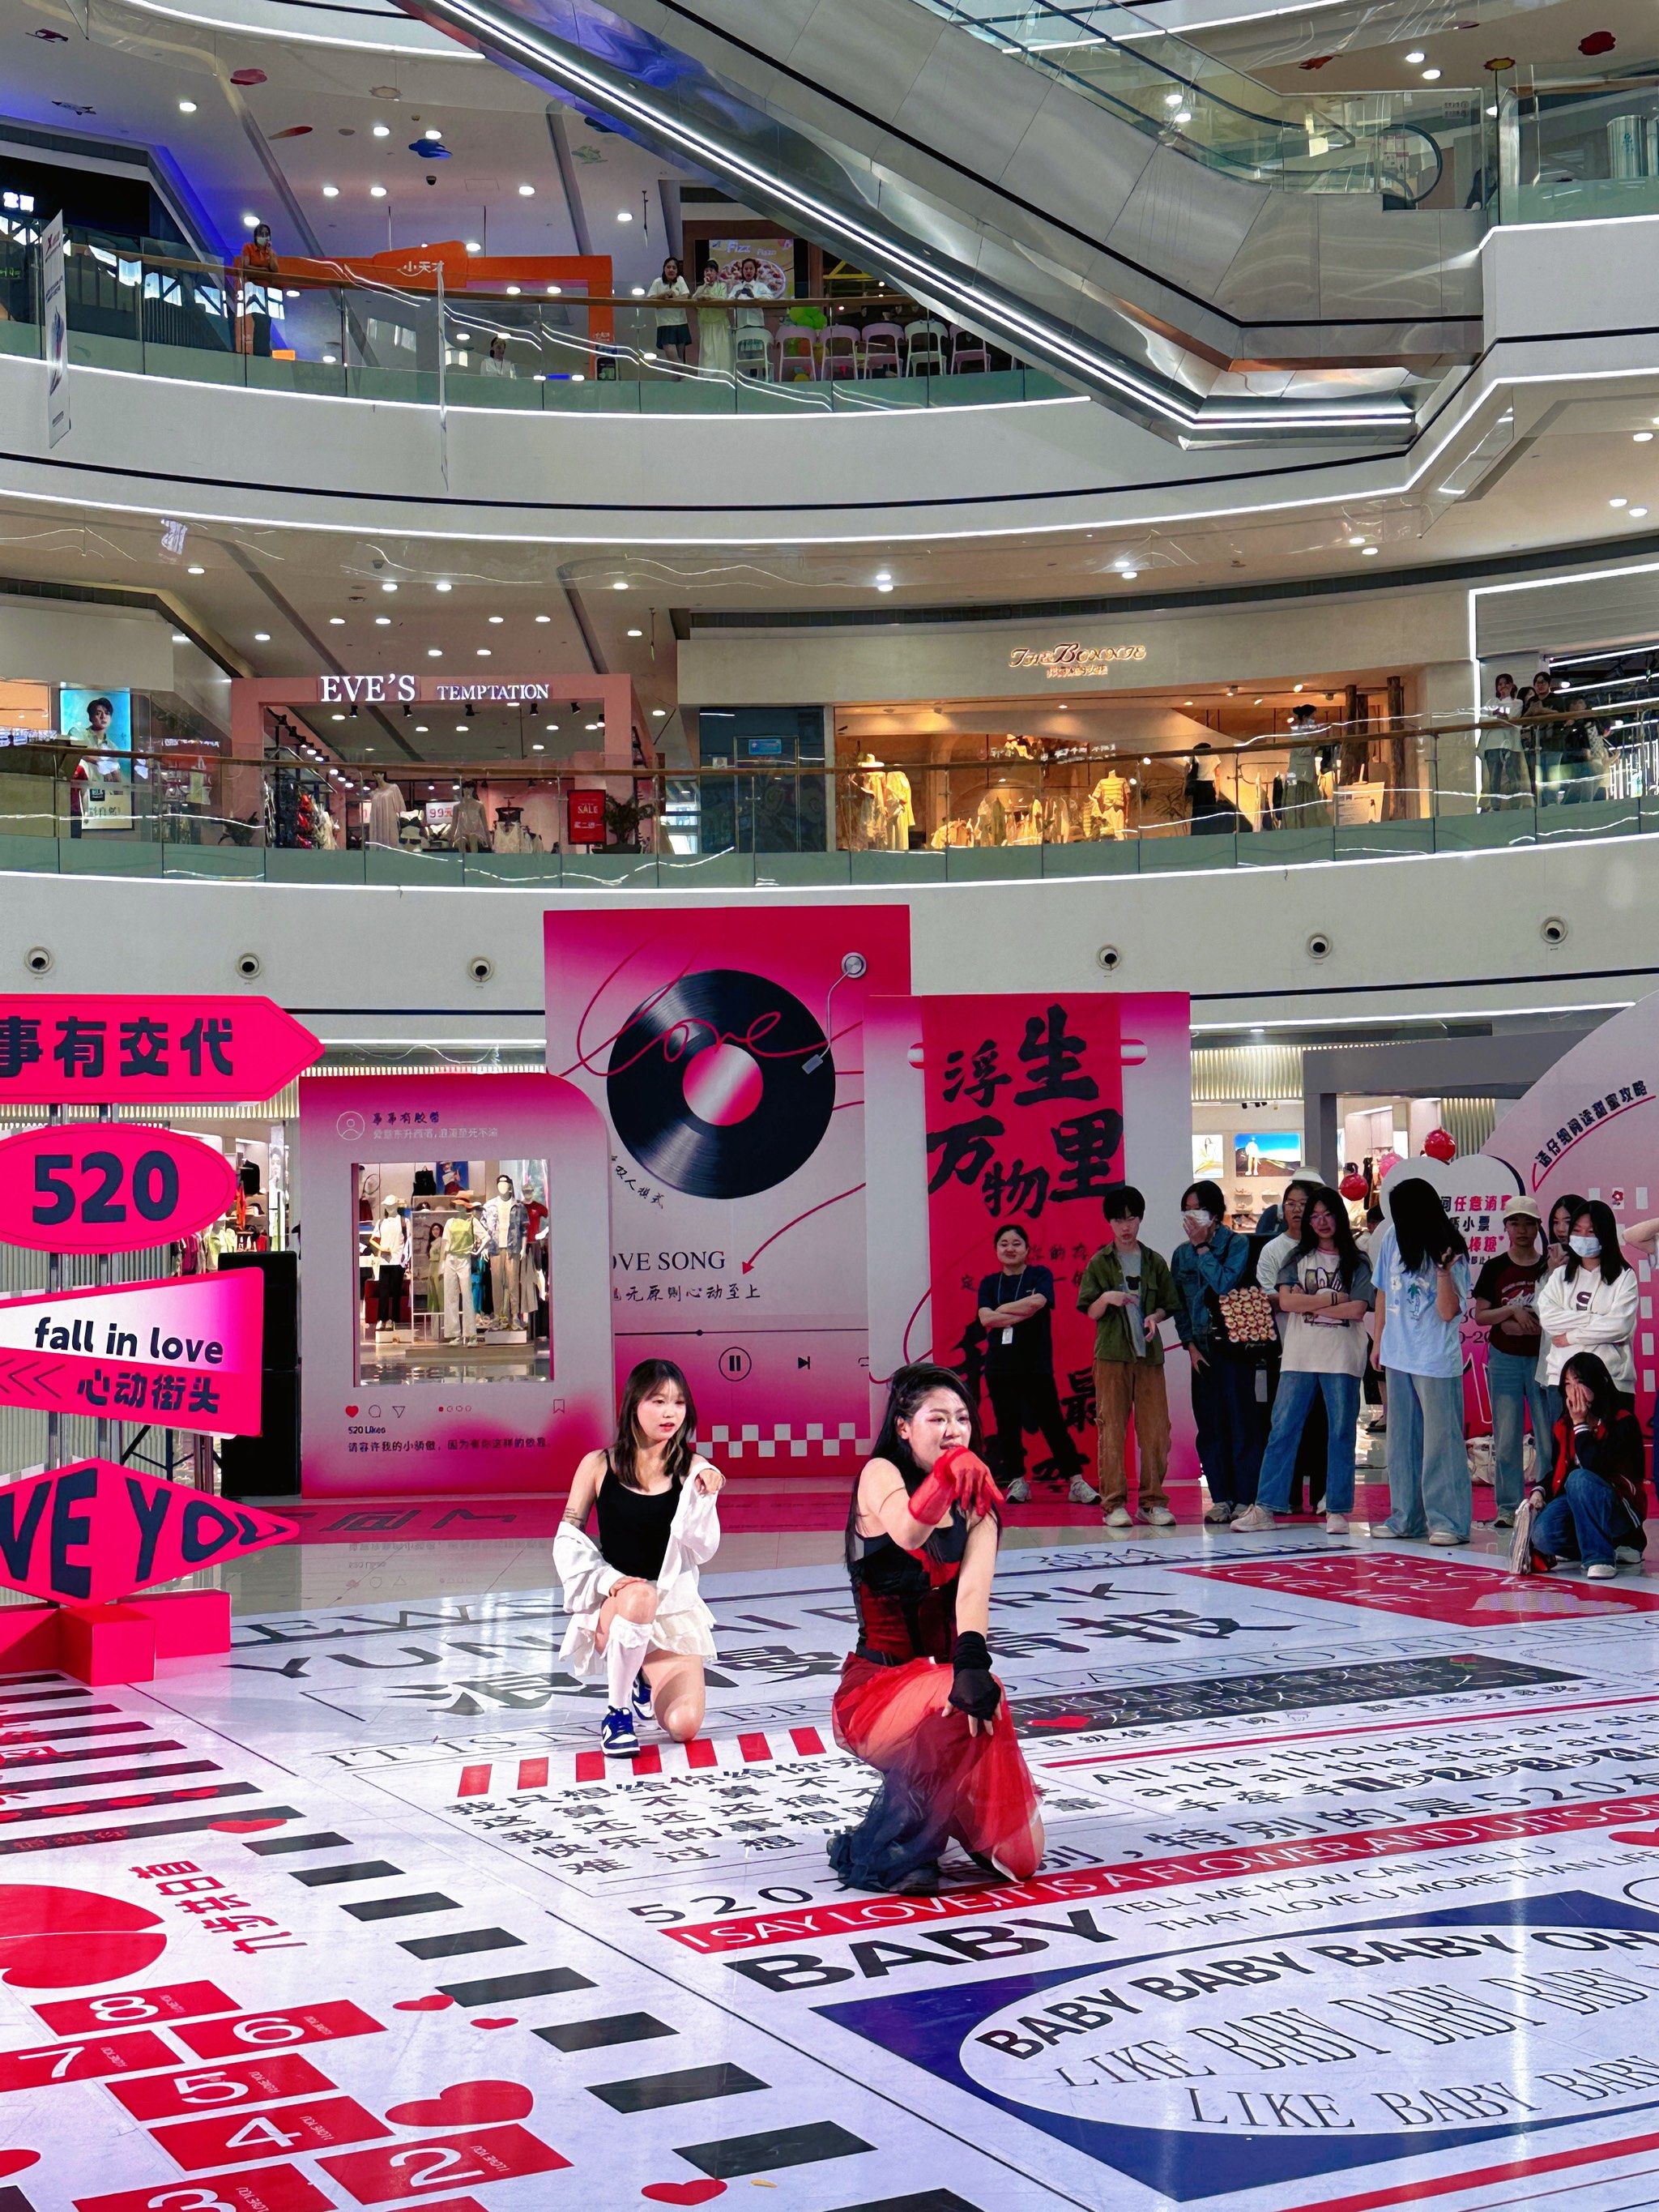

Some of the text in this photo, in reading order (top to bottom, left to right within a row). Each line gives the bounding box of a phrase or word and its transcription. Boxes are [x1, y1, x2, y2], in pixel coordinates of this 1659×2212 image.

[320, 673, 550, 702] EVE'S TEMPTATION
[578, 805, 598, 814] SALE
[32, 1151, 180, 1225] 520
[658, 1251, 726, 1271] SONG
[35, 1317, 224, 1364] fall in love
[77, 1368, 221, 1414] 心动街头
[126, 1477, 288, 1583] YOU
[232, 1598, 565, 1648] EWS
[1030, 1660, 1226, 1688] LATE
[1093, 1767, 1169, 1786] All
[1171, 1757, 1267, 1774] the
[1270, 1729, 1504, 1762] thoughts
[1508, 1722, 1592, 1737] are
[1133, 1731, 1641, 1797] and all the stars are
[1102, 1893, 1201, 1915] TELL
[1192, 1886, 1260, 1904] ME
[1255, 1873, 1350, 1893] HOW
[1354, 1860, 1433, 1880] CAN
[1439, 1851, 1531, 1866] TELL
[1520, 1845, 1555, 1855] U
[1145, 1911, 1249, 1932] THAT
[1268, 1894, 1363, 1915] LOVE
[1363, 1889, 1401, 1901] U
[1396, 1873, 1512, 1897] MORE
[1496, 1860, 1606, 1880] THAN
[680, 1932, 710, 1948] I
[710, 1914, 821, 1944] SAY
[1037, 1877, 1098, 1896] IS
[1102, 1871, 1153, 1888] A
[723, 1909, 1119, 1992] BABY
[89, 1996, 160, 2022] 8
[975, 1932, 1659, 2060] BABY BABY BABY OH
[232, 2018, 305, 2043] 6
[1054, 2039, 1218, 2087] LIKE
[1186, 2007, 1392, 2070] BABY
[1328, 1984, 1546, 2046] BABY
[18, 2046, 86, 2079] 7
[173, 2071, 249, 2104] 5
[1184, 2086, 1356, 2129] LIKE
[1371, 2082, 1543, 2126] BABY
[224, 2116, 303, 2149] 4
[390, 2147, 486, 2188] 2
